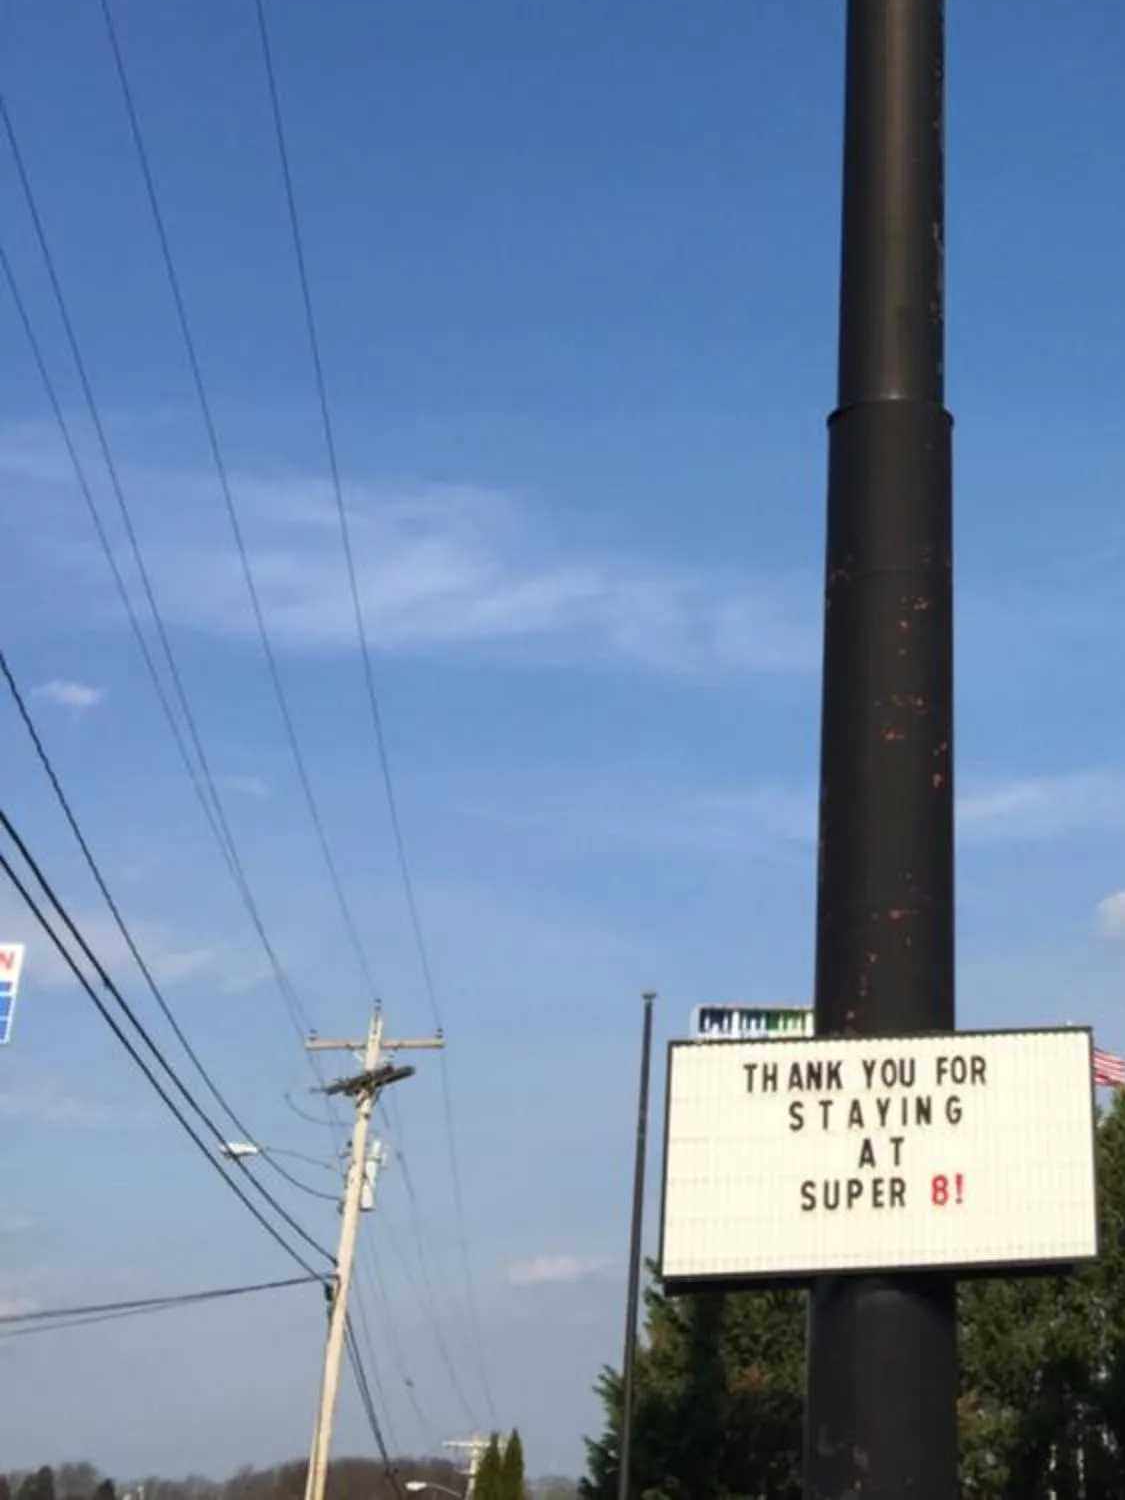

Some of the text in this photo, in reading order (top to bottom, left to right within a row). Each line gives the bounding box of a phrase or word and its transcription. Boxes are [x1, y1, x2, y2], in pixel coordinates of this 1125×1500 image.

[743, 1055, 987, 1093] THANK YOU FOR
[788, 1095, 963, 1132] STAYING
[858, 1136, 905, 1169] AT
[800, 1173, 964, 1212] SUPER 8!
